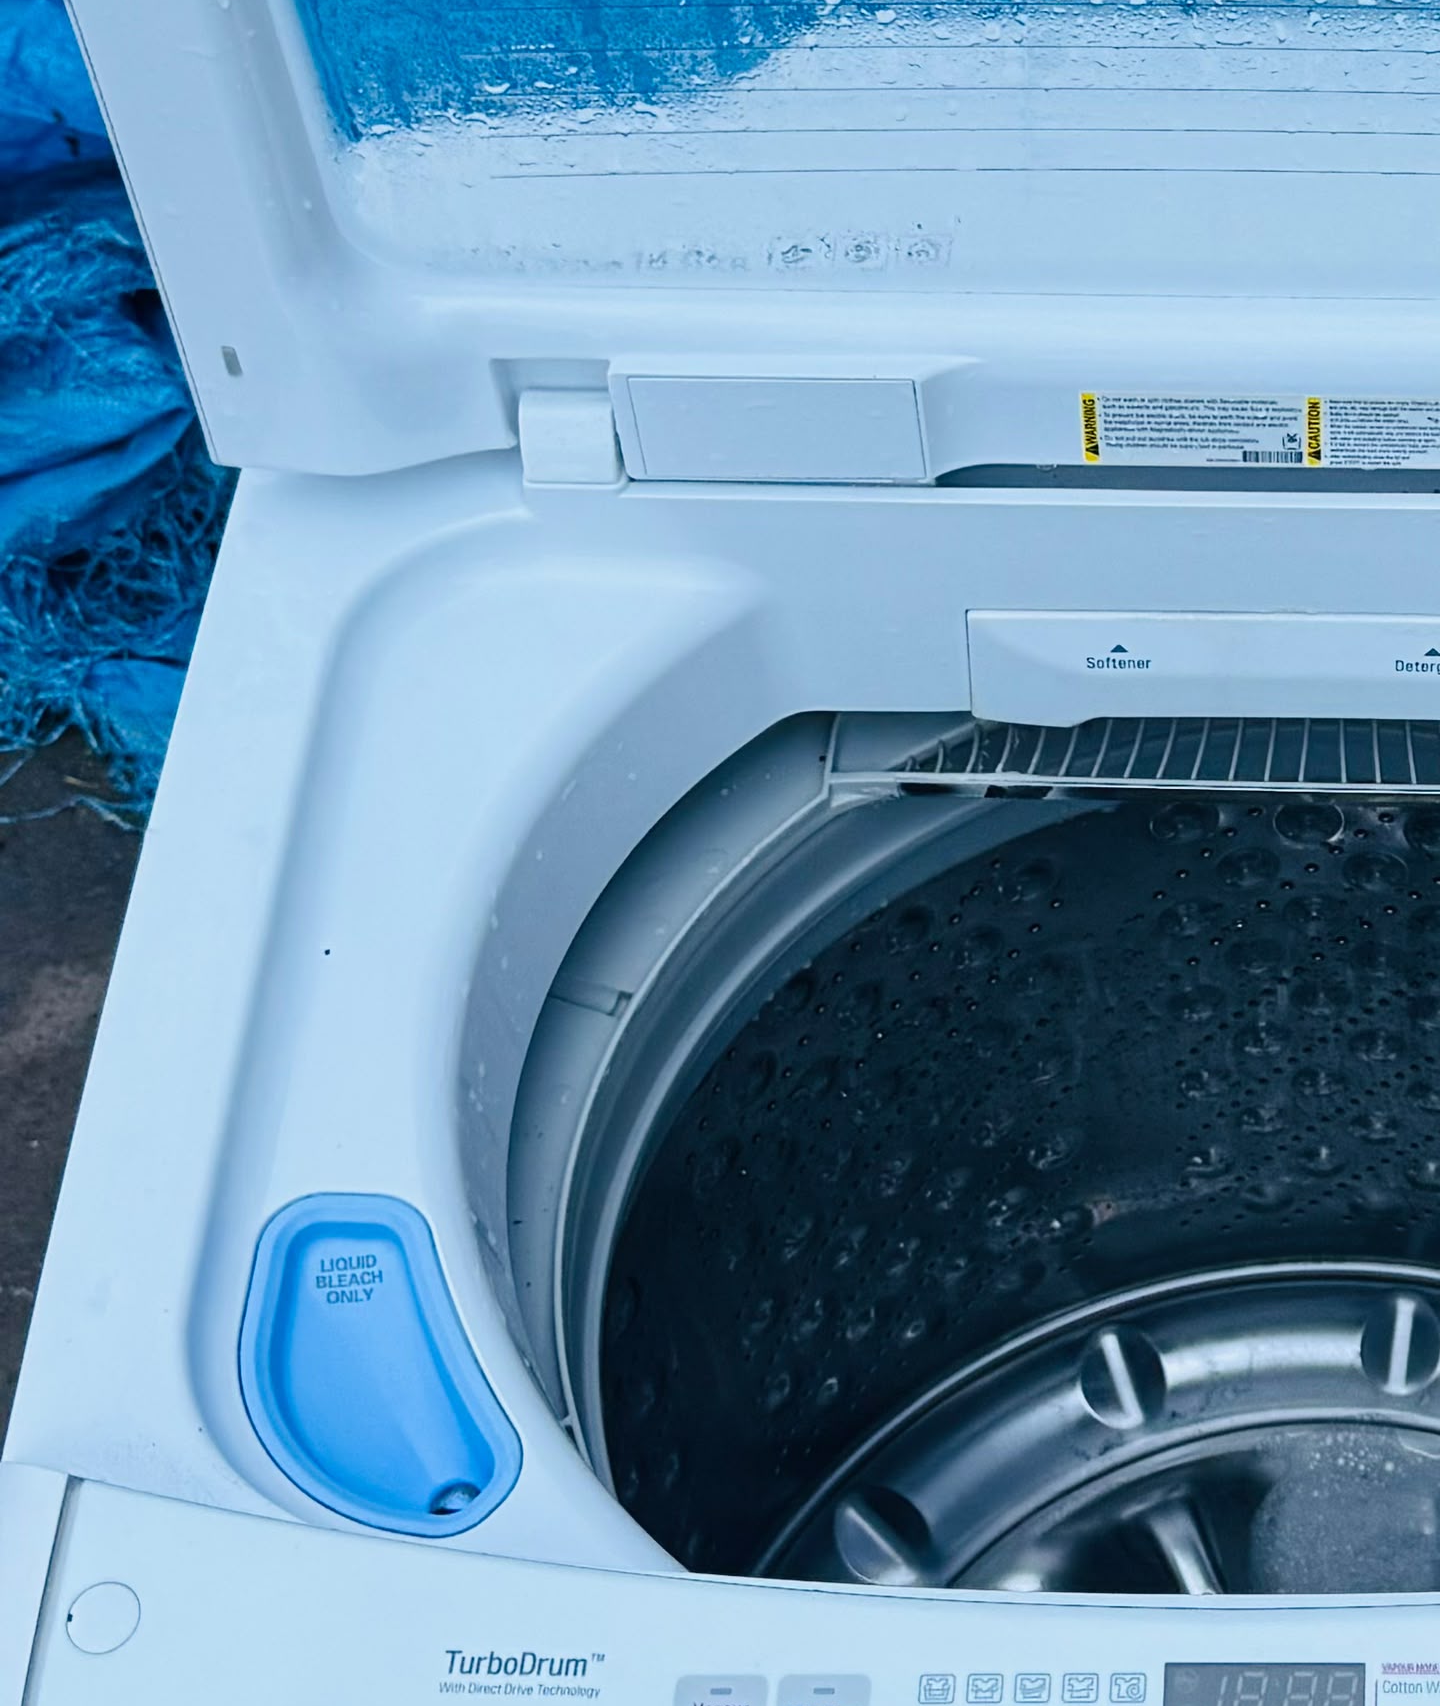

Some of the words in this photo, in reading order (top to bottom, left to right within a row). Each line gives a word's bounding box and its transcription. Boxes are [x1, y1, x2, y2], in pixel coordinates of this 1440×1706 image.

[1082, 398, 1099, 445] WARNING
[1307, 398, 1321, 450] CAUTION
[1086, 656, 1152, 670] Softener
[320, 1254, 377, 1273] LIQUID
[315, 1270, 383, 1290] BLEACH
[326, 1288, 374, 1305] ONLY
[439, 1681, 466, 1694] With
[468, 1682, 501, 1695] Direct
[504, 1683, 533, 1696] Drive
[537, 1684, 601, 1699] Technology
[1382, 1680, 1423, 1694] Cotton
